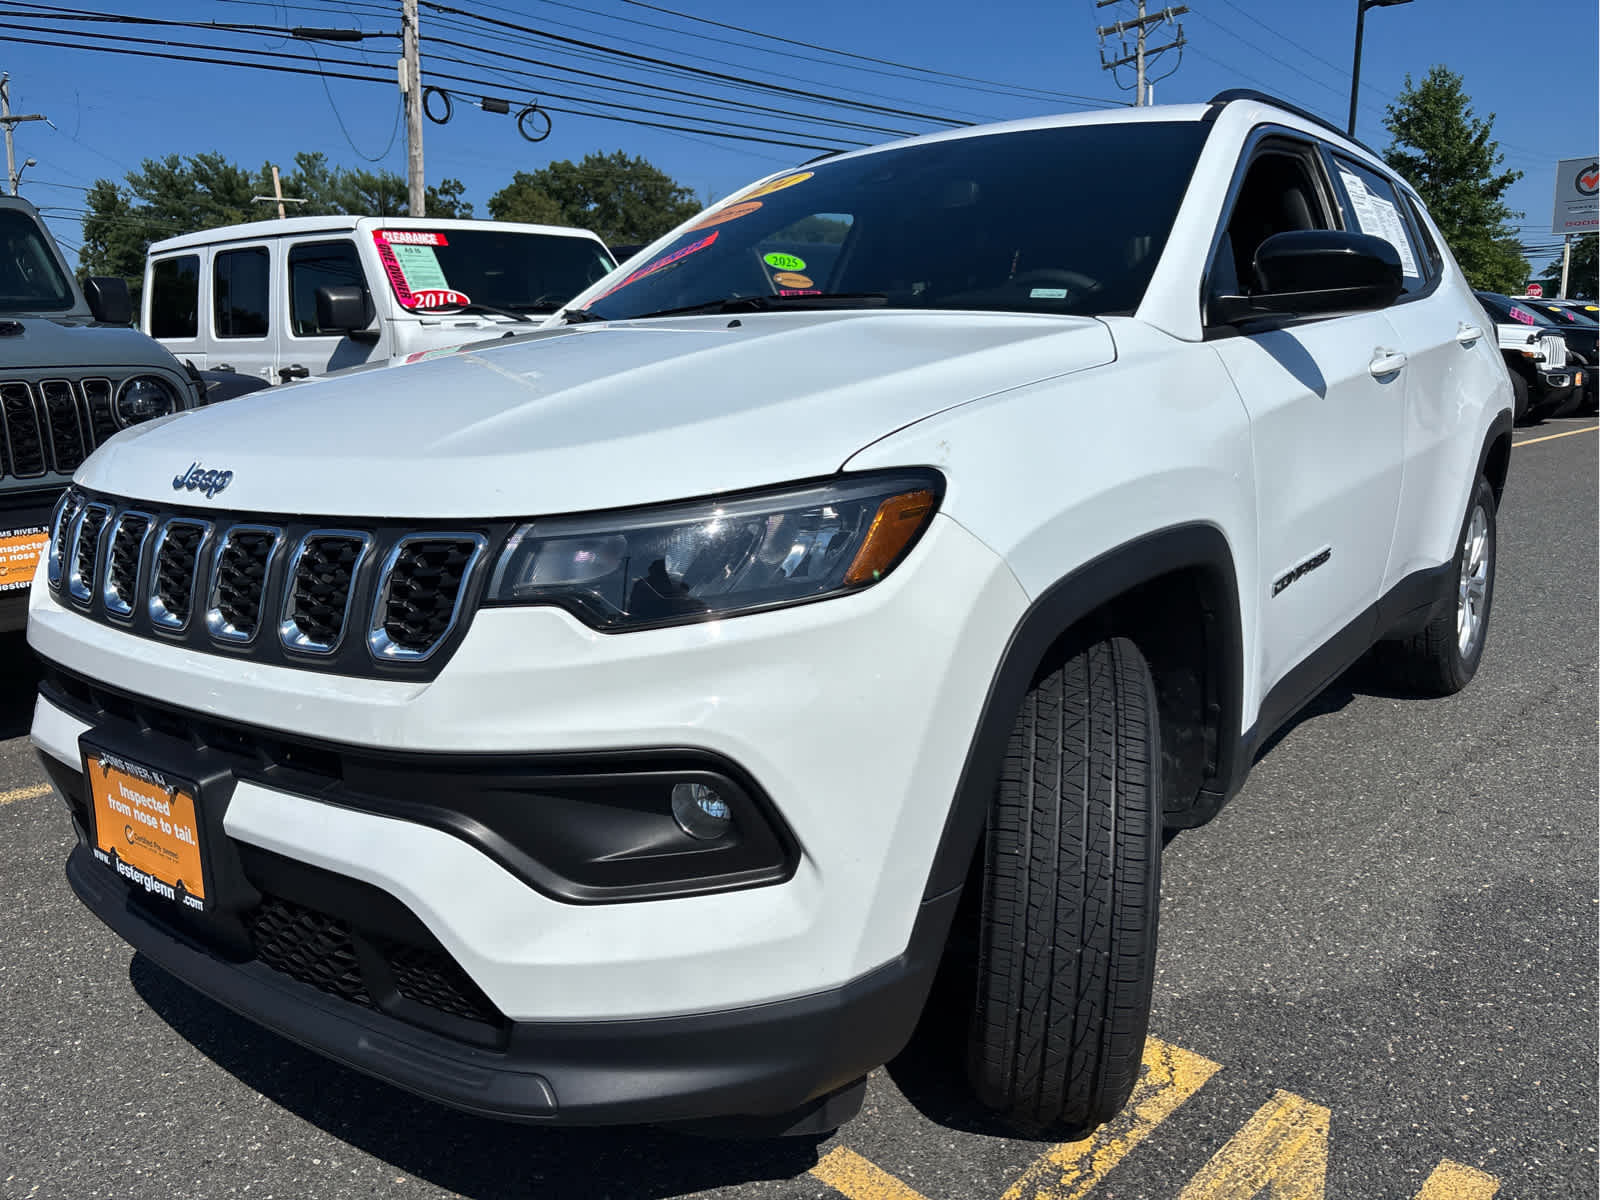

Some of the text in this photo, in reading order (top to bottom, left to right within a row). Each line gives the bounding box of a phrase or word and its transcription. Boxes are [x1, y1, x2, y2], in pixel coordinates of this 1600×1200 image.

[382, 232, 440, 246] CLEARANCE
[378, 243, 412, 299] ONE OWNER
[772, 255, 799, 268] 2025
[414, 293, 457, 307] 2019
[172, 461, 234, 499] Jeep
[9, 552, 35, 560] nose
[1271, 547, 1332, 600] COMPASS
[118, 780, 171, 817] Inspected
[107, 793, 196, 847] from nose to tail.
[93, 848, 205, 911] www. lesterglenn .com
